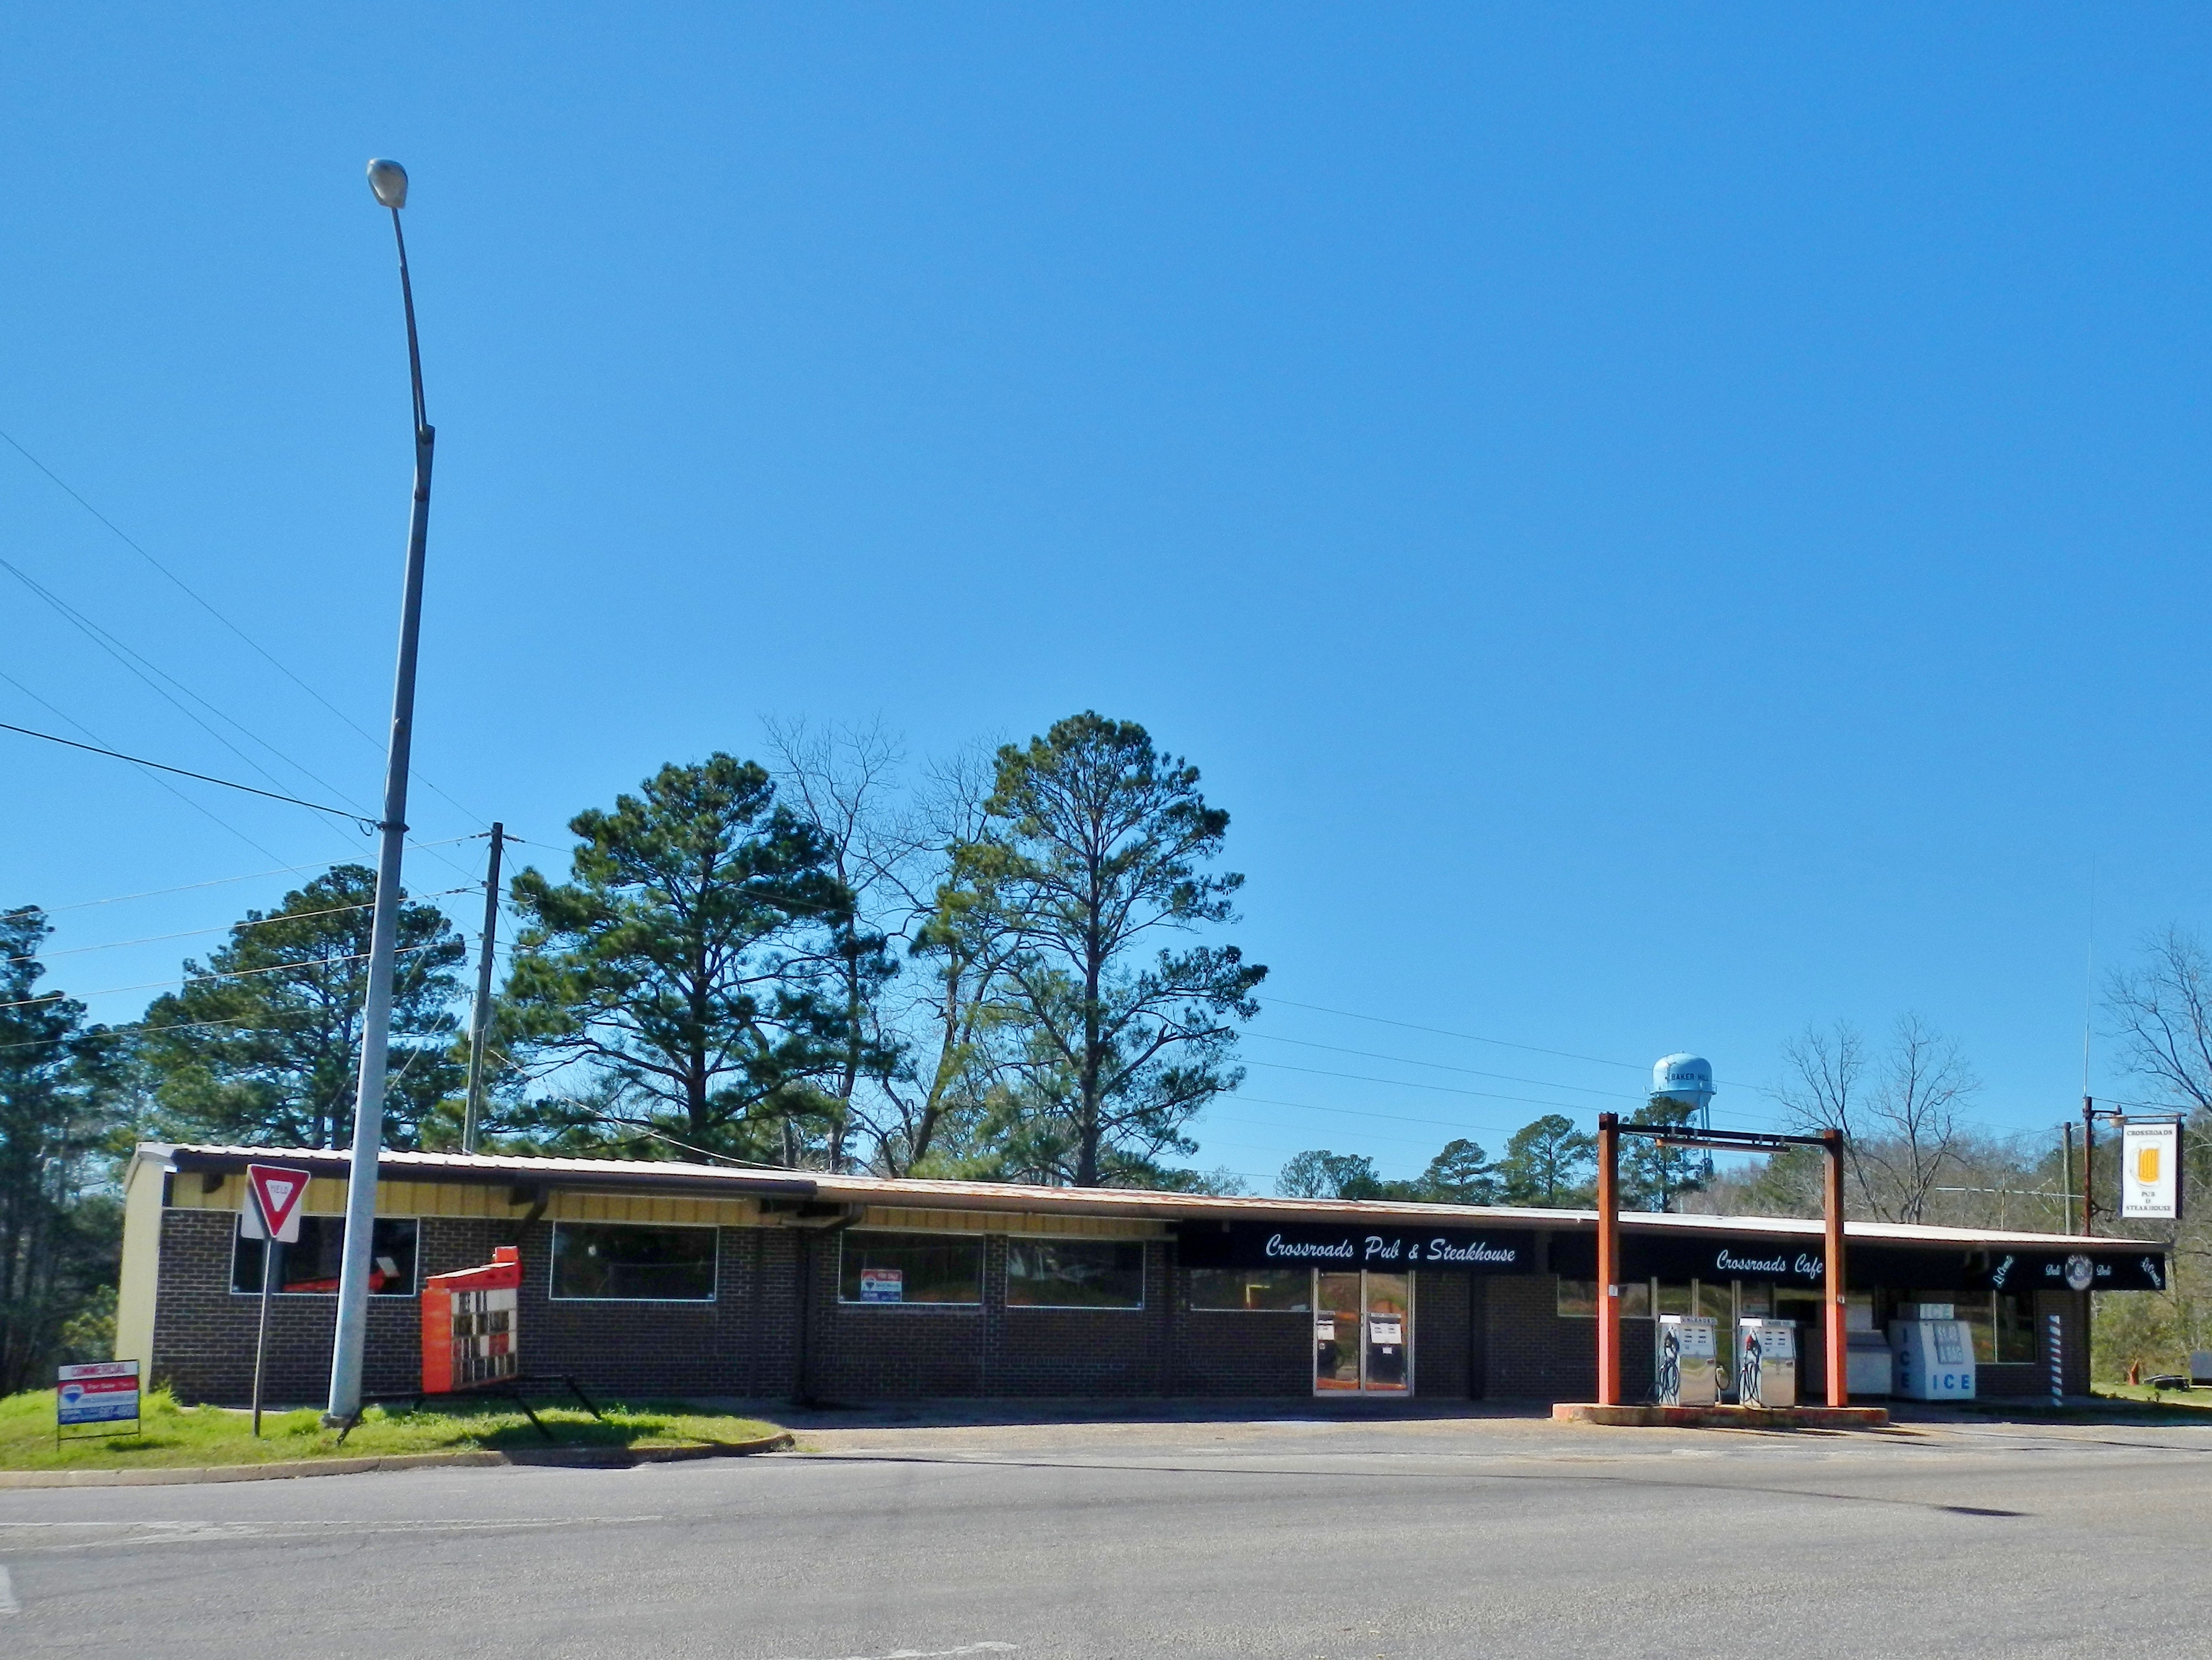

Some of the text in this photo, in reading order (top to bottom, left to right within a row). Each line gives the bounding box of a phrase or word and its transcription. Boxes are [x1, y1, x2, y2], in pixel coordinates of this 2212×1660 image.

[1671, 1073, 1695, 1081] BAKER
[270, 1185, 289, 1194] YIELD
[1266, 1233, 1516, 1262] Crossroads Pub & Steakhouse
[1716, 1249, 1823, 1280] Crossroads Cafe
[2045, 1264, 2062, 1276] Deli
[2096, 1264, 2112, 1276] Deli
[1899, 1328, 1911, 1389] ICE
[1933, 1374, 1970, 1390] ICE
